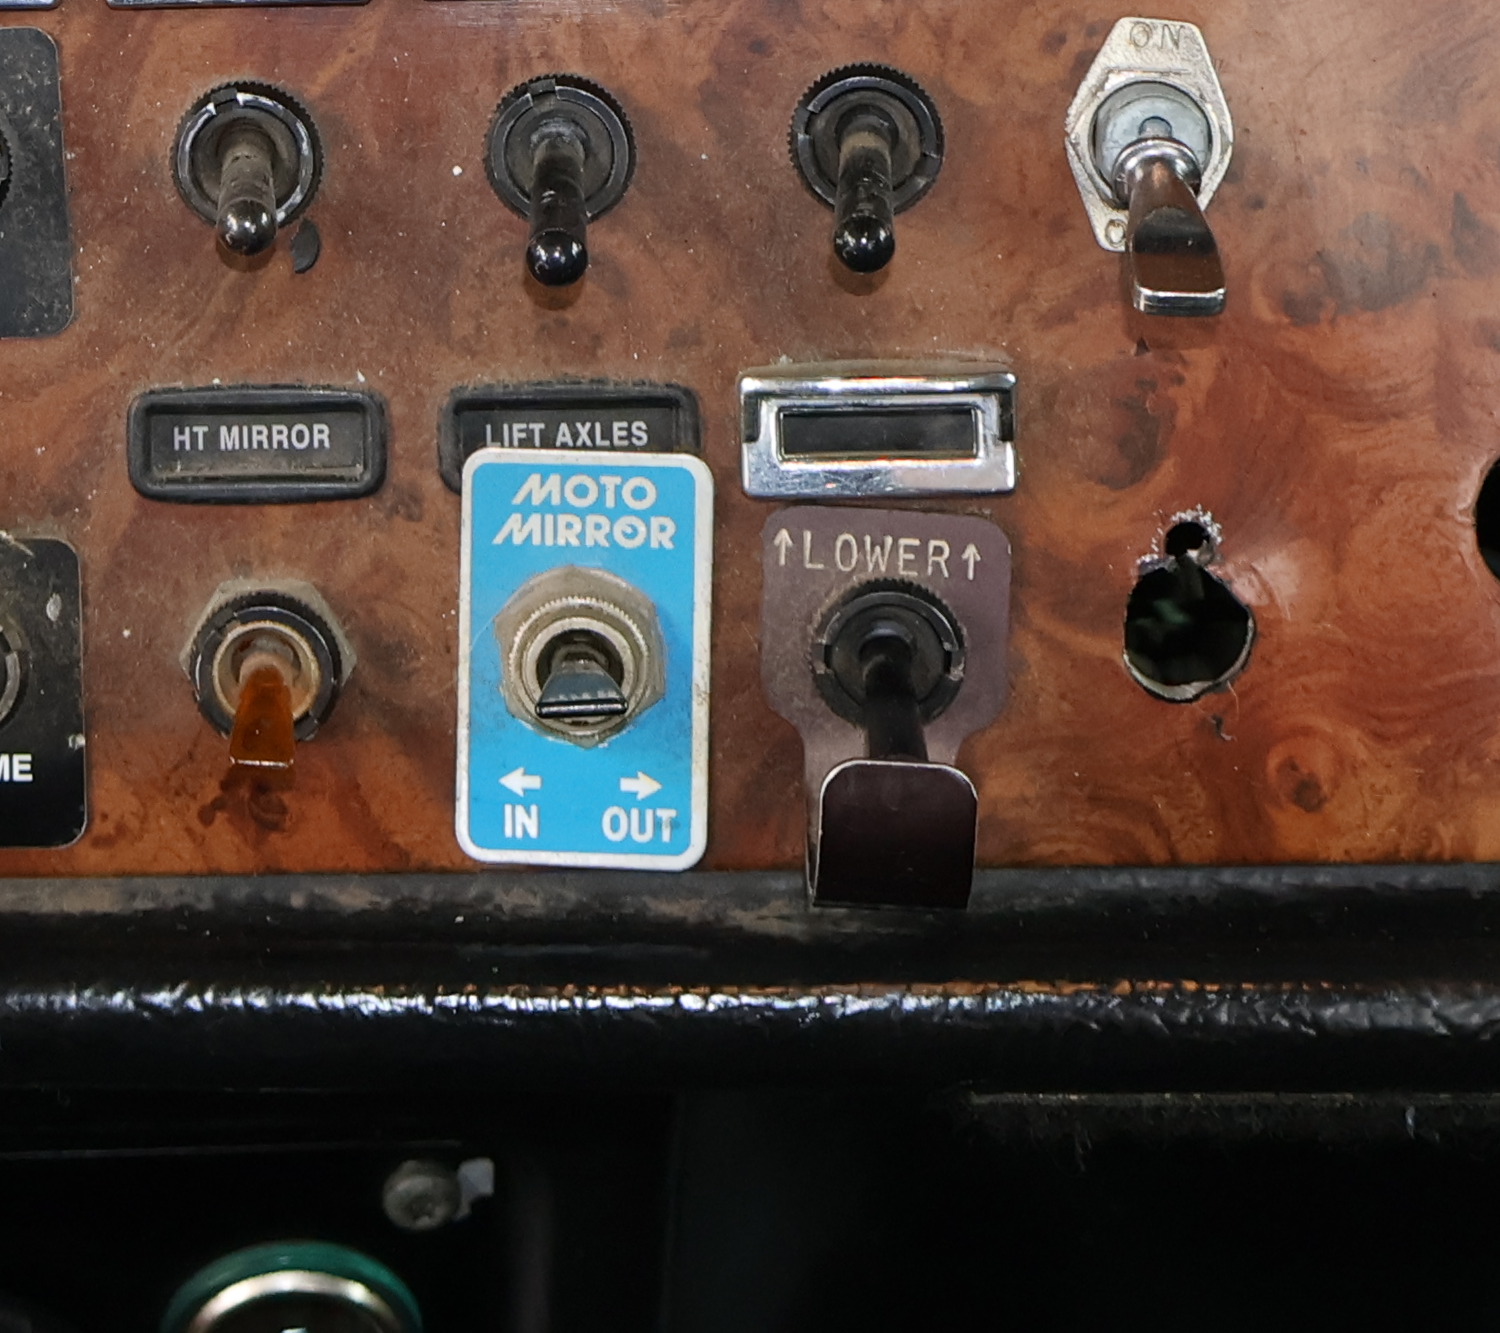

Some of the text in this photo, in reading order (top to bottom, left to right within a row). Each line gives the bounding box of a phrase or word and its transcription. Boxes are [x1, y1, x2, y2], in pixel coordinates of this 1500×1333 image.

[1130, 22, 1183, 51] ON
[173, 423, 331, 451] HT MIRROR
[485, 421, 649, 450] LIFT AXLES
[512, 474, 657, 509] MOTO
[492, 514, 677, 549] MIRROR
[803, 530, 951, 579] LOWER
[503, 804, 539, 839] IN
[602, 808, 677, 844] OUT
